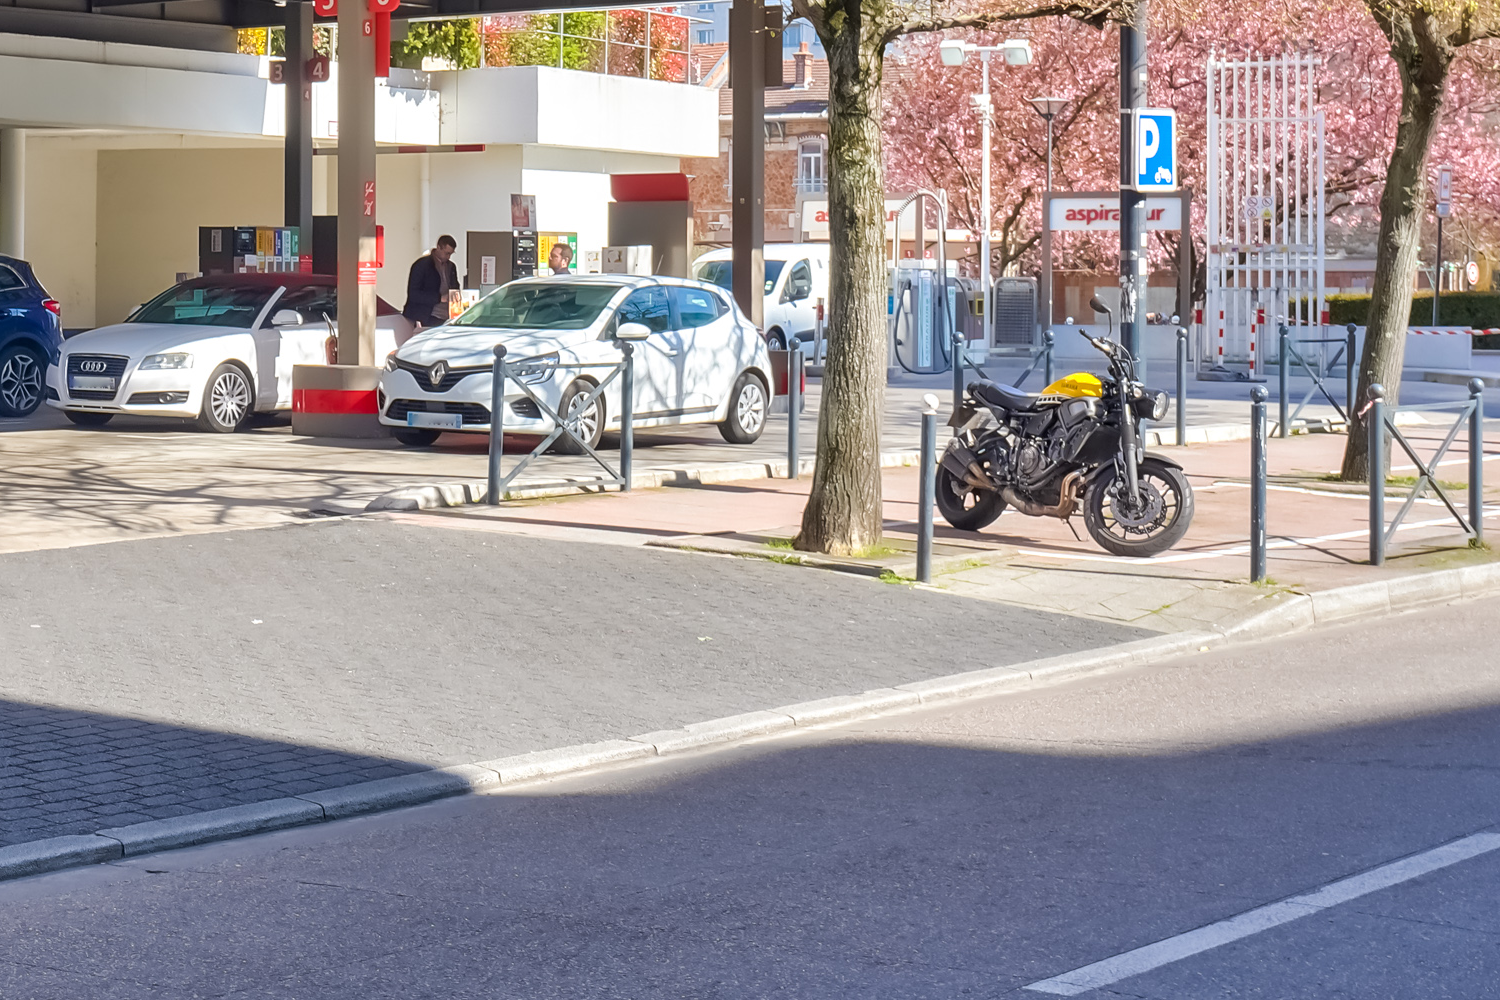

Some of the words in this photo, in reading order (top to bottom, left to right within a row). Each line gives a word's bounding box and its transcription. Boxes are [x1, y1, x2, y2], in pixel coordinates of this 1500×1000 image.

[364, 21, 371, 34] 6
[274, 64, 283, 81] 3
[312, 61, 324, 79] 4
[1138, 117, 1160, 175] P
[1065, 204, 1166, 226] aspiraur
